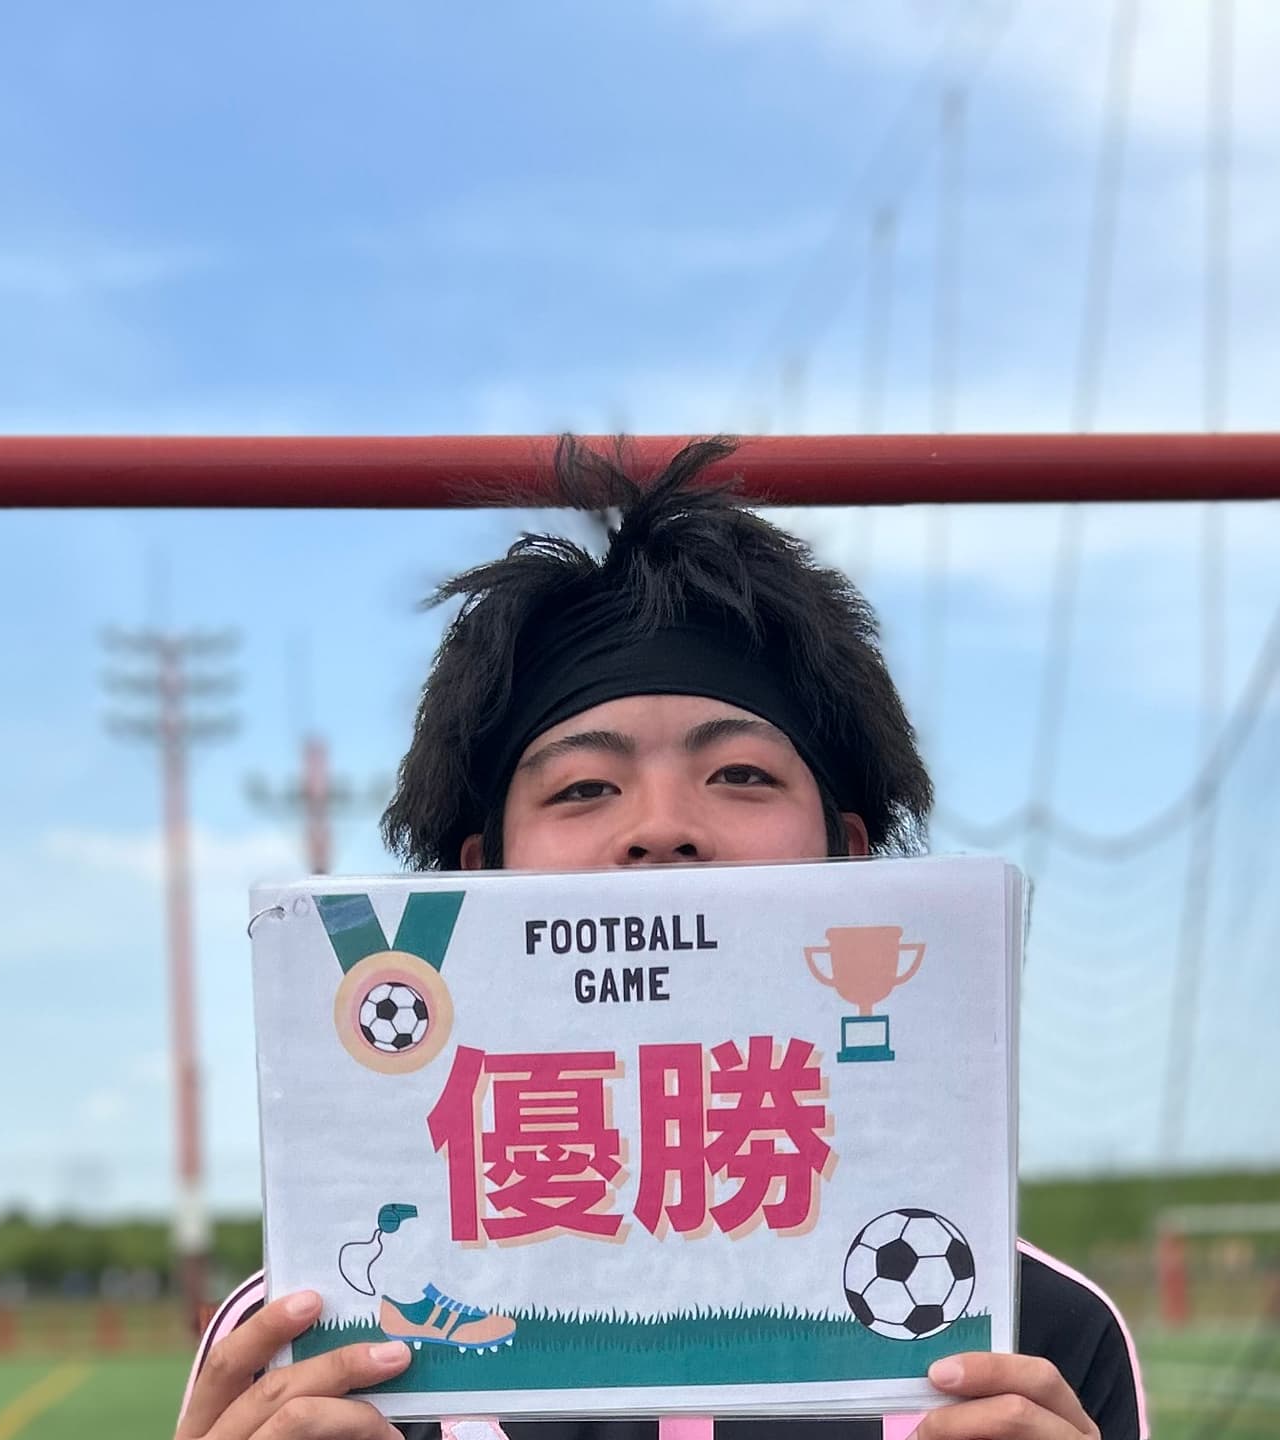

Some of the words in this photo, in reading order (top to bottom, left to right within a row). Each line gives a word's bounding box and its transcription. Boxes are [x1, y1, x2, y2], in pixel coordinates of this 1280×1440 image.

[525, 914, 718, 955] FOOTBALL
[574, 966, 671, 1004] GAME
[427, 1035, 837, 1247] 優勝
